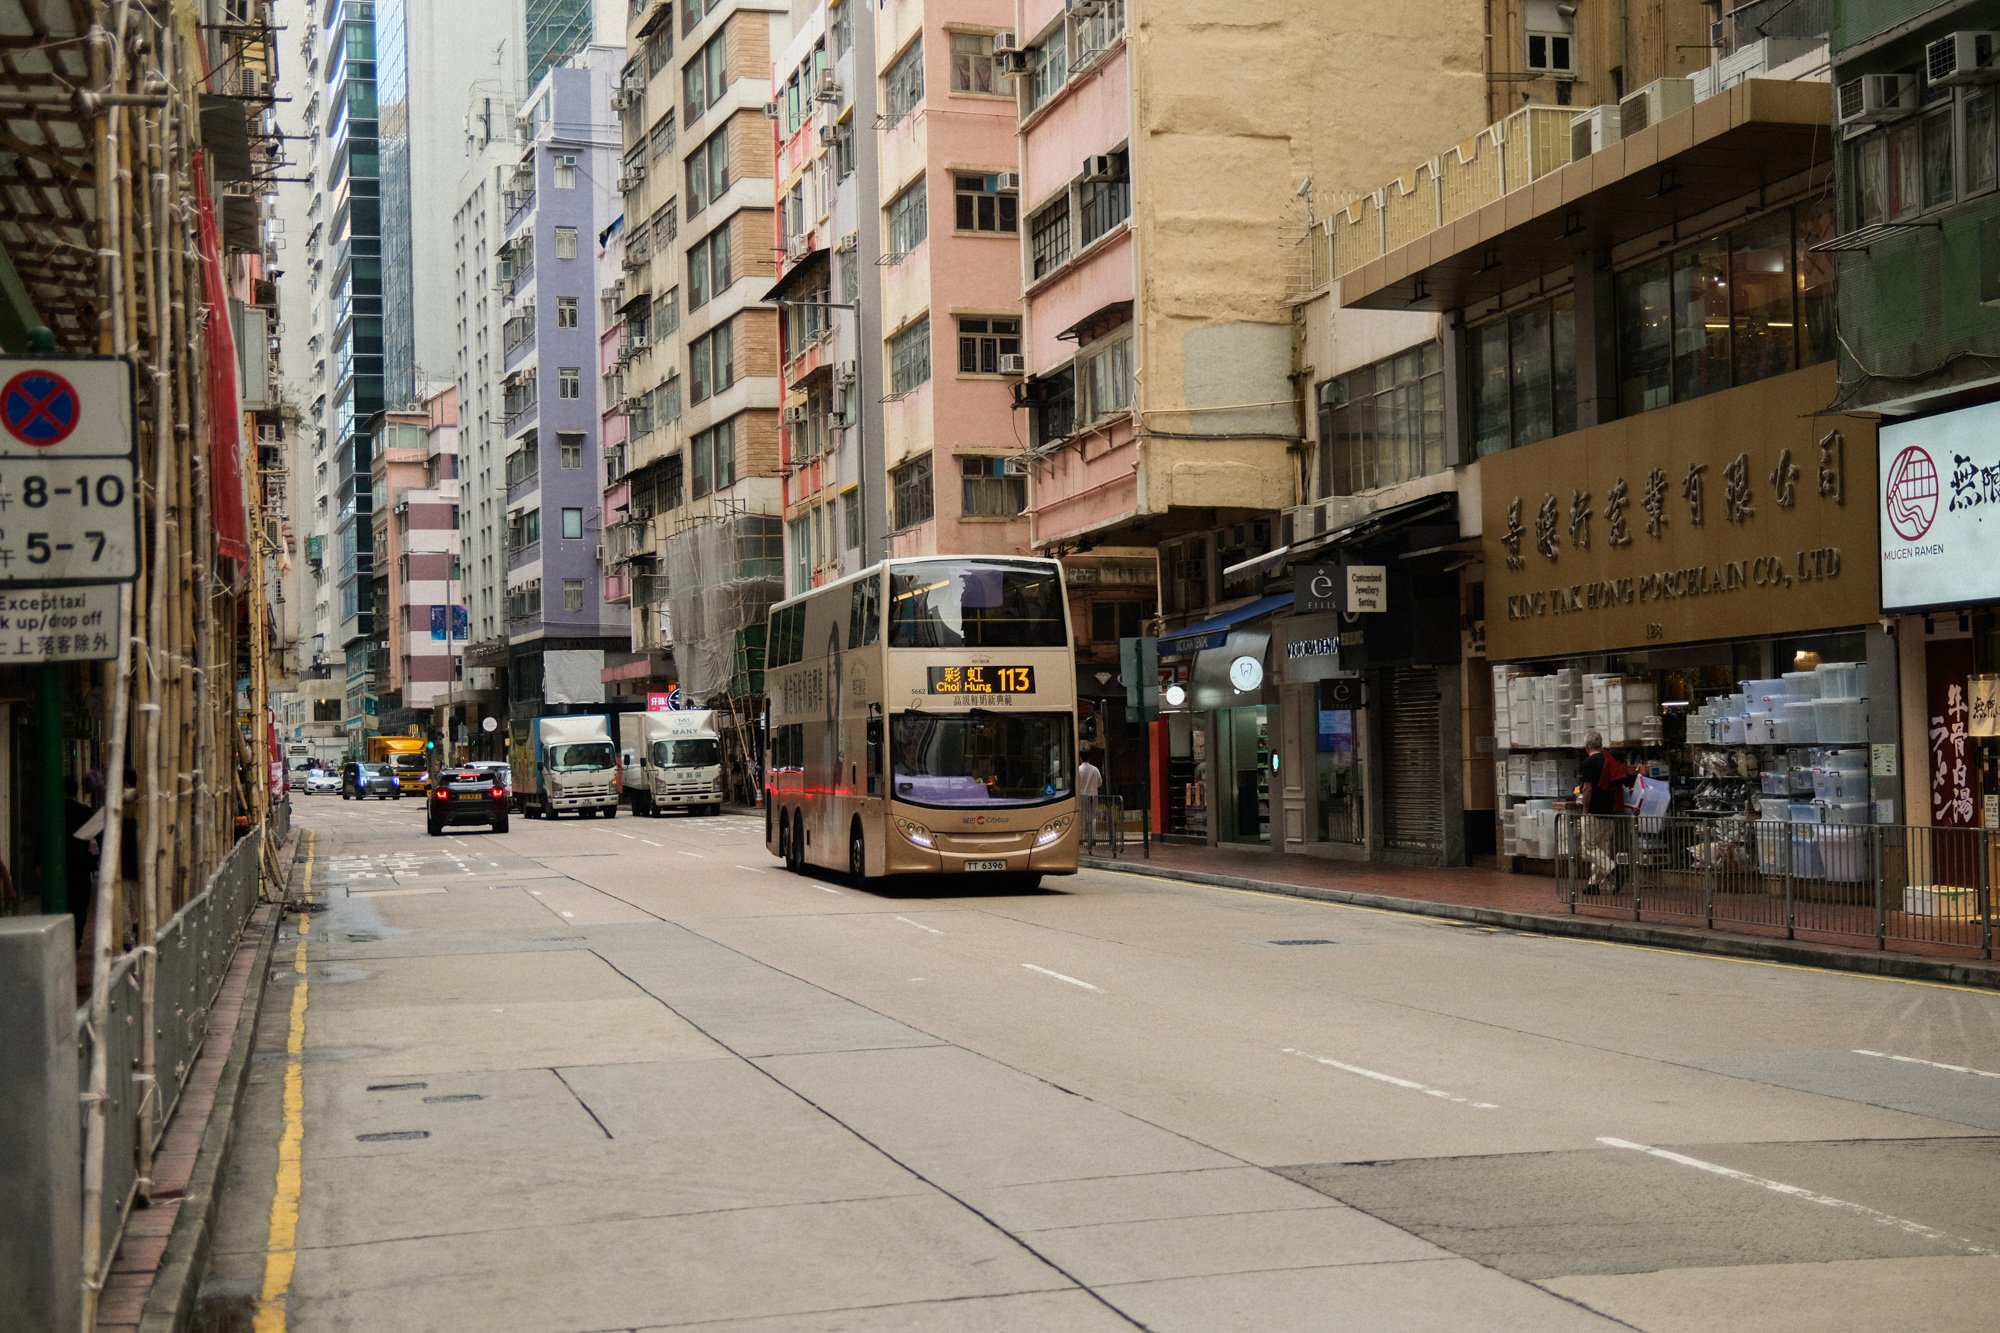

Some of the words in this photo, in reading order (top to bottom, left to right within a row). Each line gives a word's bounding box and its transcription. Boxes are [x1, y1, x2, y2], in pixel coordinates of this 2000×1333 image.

[23, 474, 125, 509] 8-10
[1884, 549, 1913, 560] MUGEN
[1915, 544, 1944, 557] RAMEN
[1508, 592, 1546, 620] KING
[1550, 585, 1584, 615] TAK
[1587, 577, 1634, 609] HONG
[1639, 560, 1749, 603] PORCELAIN
[1796, 547, 1841, 583] LTD
[61, 593, 86, 609] taxi
[1308, 601, 1336, 610] ELLIS
[82, 610, 102, 626] off
[945, 667, 984, 682] 彩虹
[997, 668, 1030, 691] 113
[936, 682, 960, 692] Choi
[964, 682, 992, 693] Hung
[981, 862, 1003, 870] 6396
